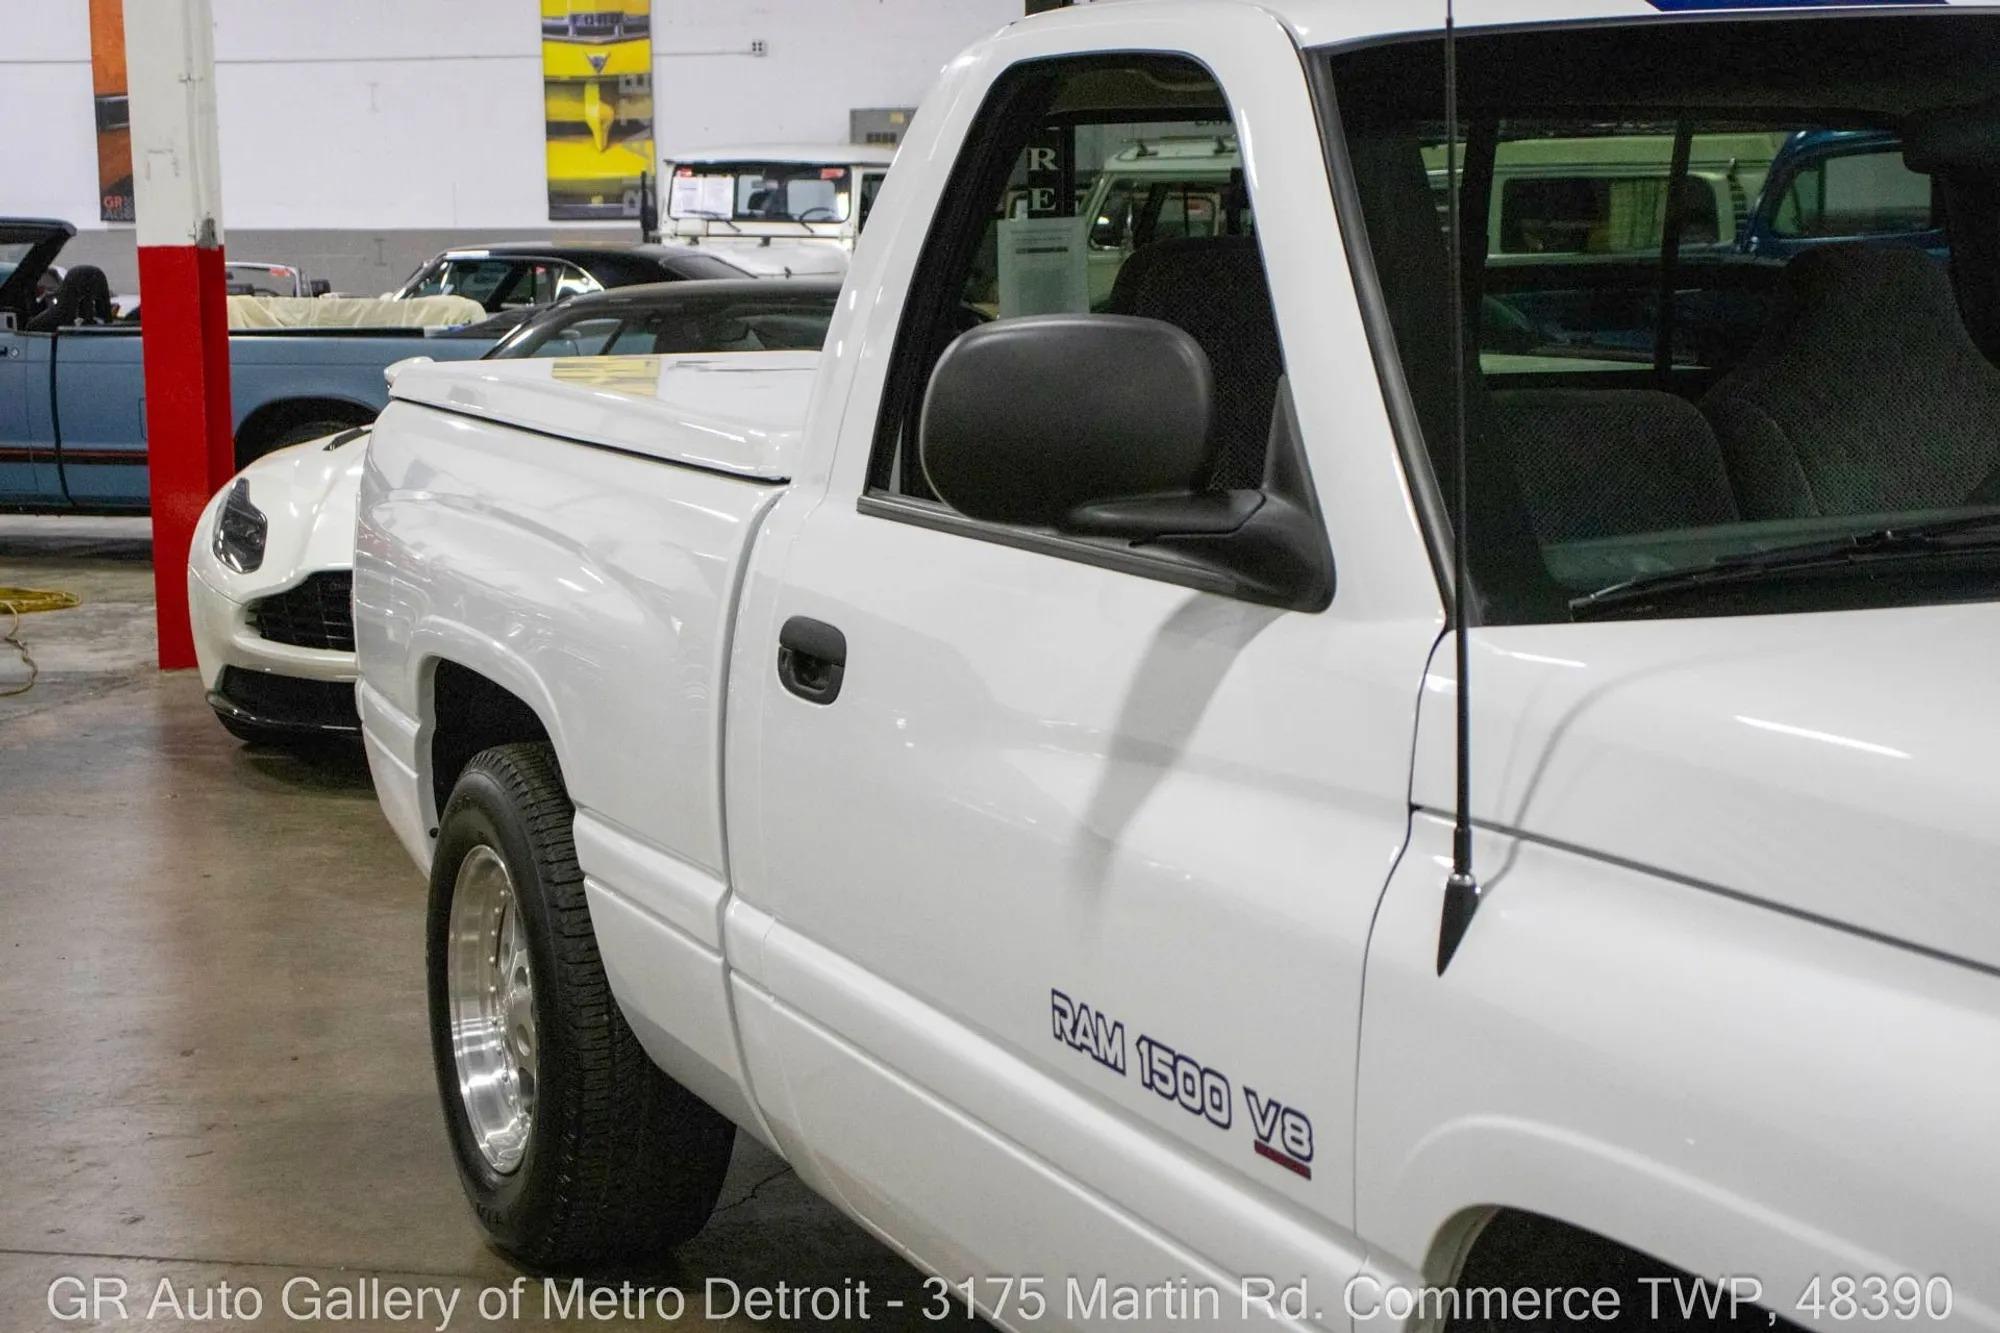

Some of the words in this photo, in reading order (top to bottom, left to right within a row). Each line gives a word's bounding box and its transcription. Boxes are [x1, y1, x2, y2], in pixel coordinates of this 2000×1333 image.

[1051, 988, 1126, 1077] RAM
[1136, 1034, 1232, 1130] 1500
[1243, 1085, 1314, 1163] V8
